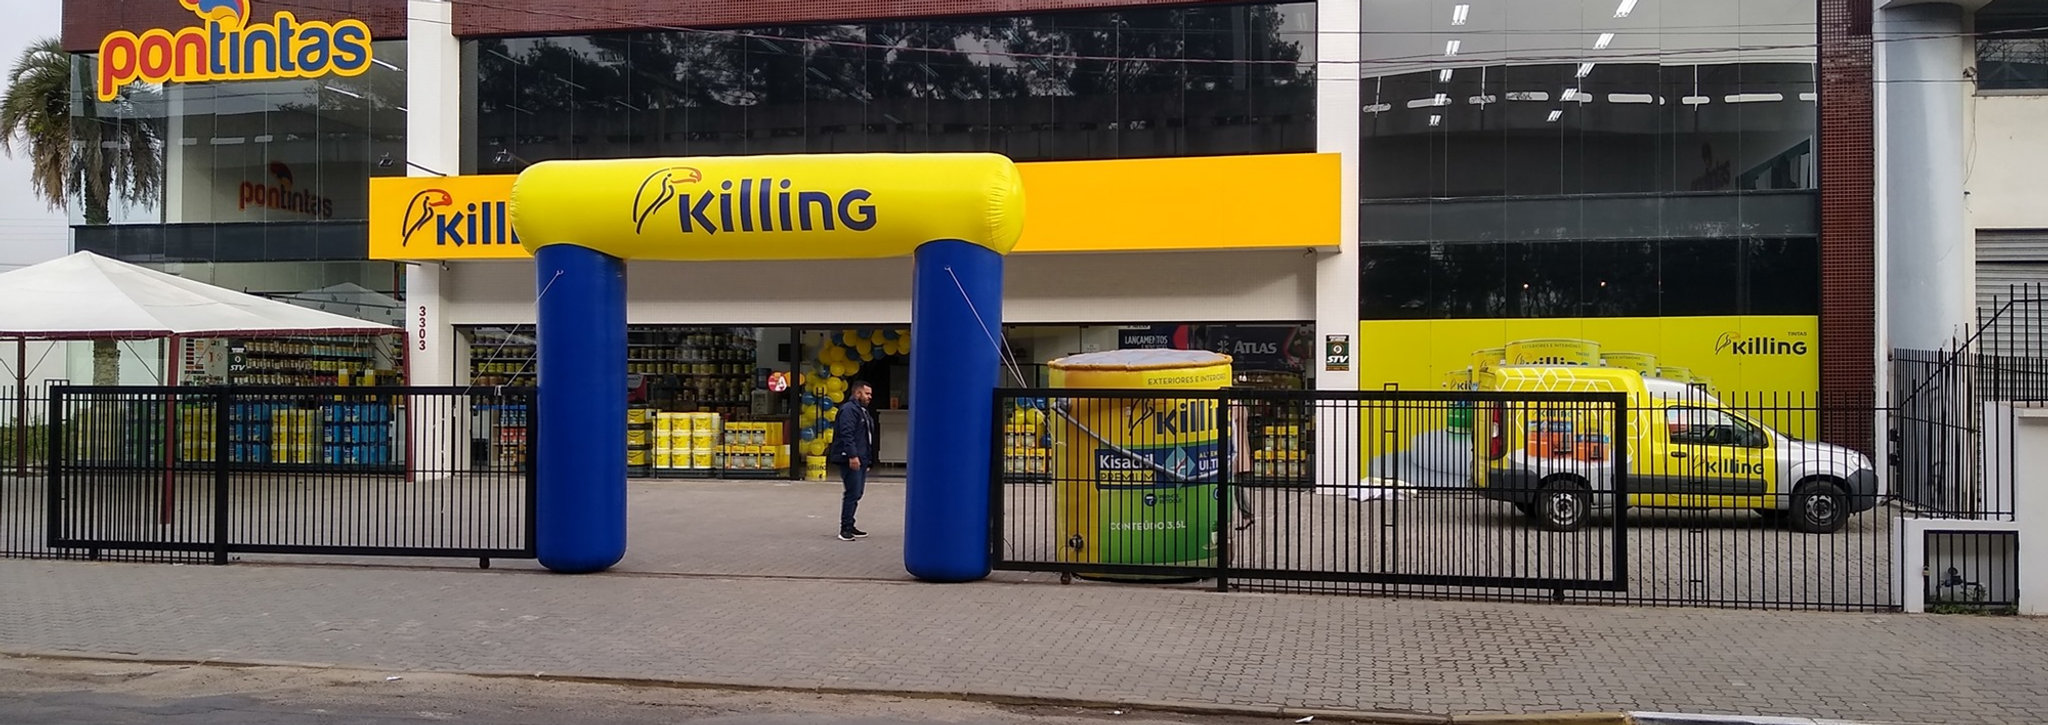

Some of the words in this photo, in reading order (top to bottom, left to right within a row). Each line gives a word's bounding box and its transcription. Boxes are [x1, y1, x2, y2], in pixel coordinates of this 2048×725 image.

[102, 17, 366, 96] pontintas
[239, 180, 333, 218] pontintas
[418, 306, 426, 350] 3303
[1233, 340, 1277, 354] ATLAS
[1326, 355, 1349, 363] STV
